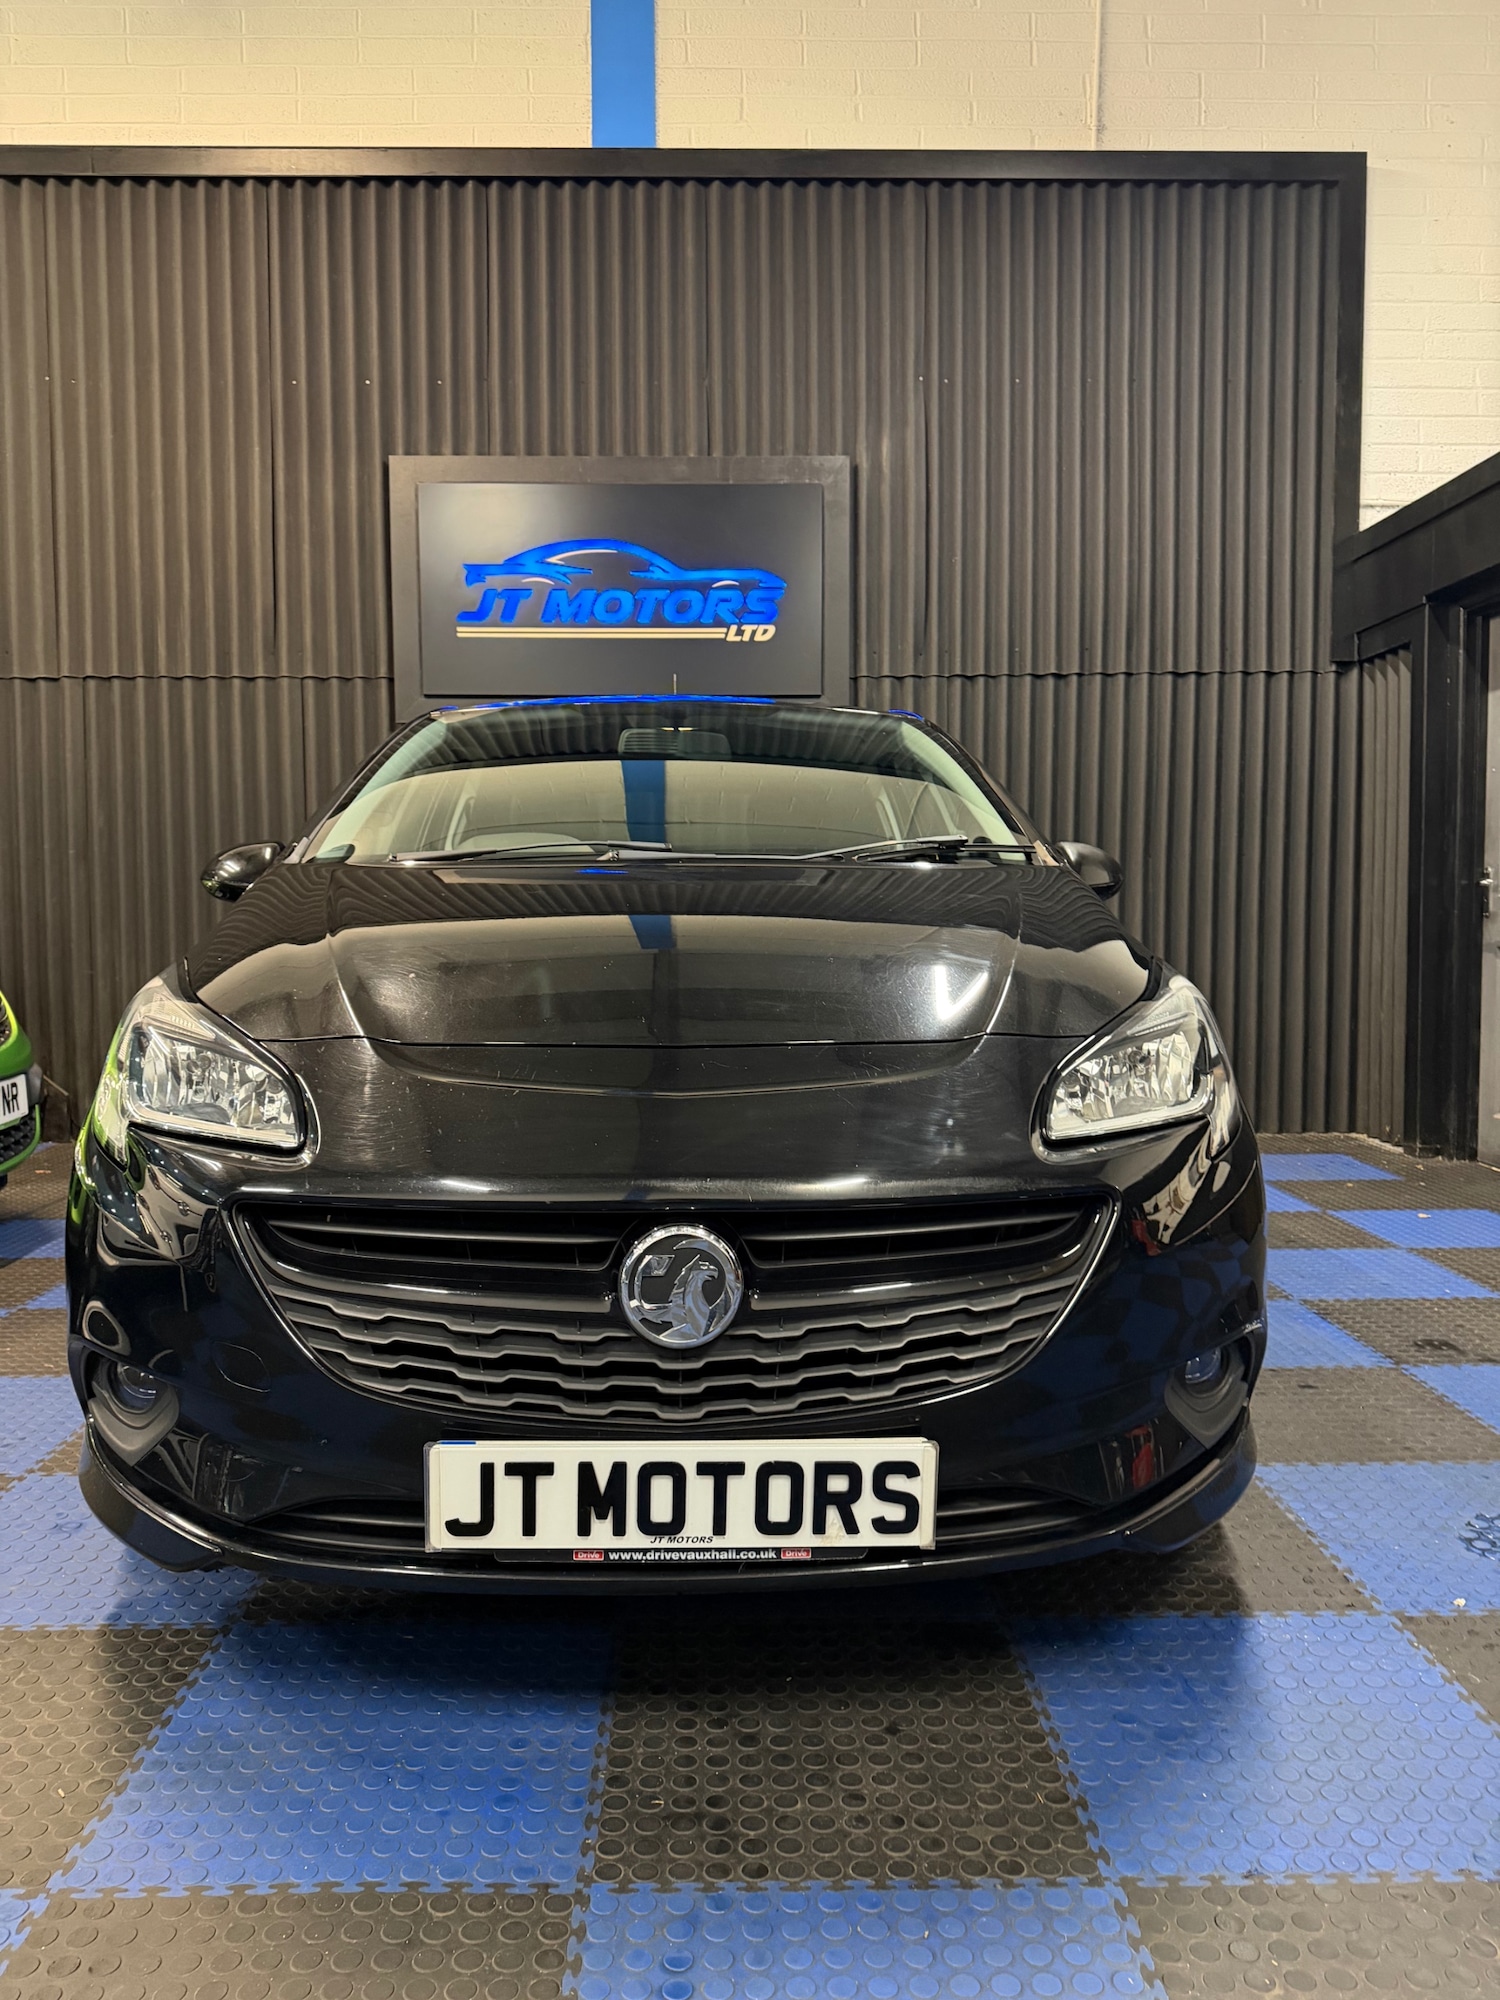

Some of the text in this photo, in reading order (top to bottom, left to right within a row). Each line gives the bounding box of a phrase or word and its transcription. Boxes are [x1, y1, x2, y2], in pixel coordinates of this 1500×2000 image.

[456, 588, 785, 624] JT MOTORS
[725, 624, 776, 642] LTD
[444, 1460, 921, 1537] JT MOTORS
[649, 1536, 665, 1544] JT
[667, 1536, 714, 1544] MOTORS
[608, 1549, 777, 1561] www.drivevauxhall.co.uk
